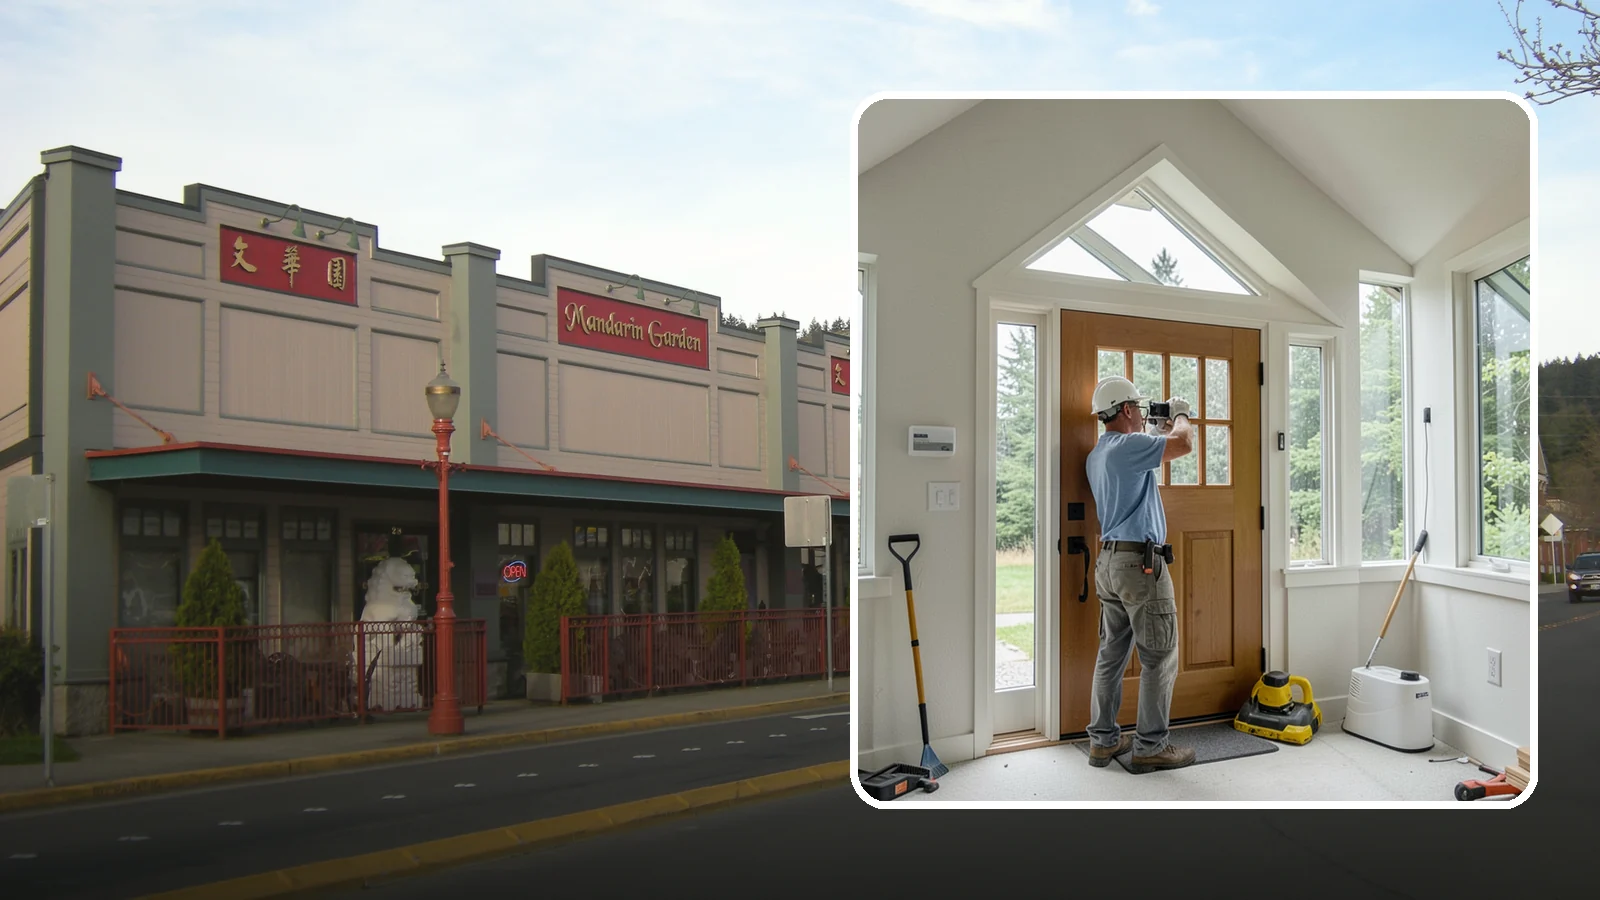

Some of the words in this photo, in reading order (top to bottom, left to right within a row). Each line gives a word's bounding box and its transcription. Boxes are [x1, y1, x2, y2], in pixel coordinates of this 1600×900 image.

[231, 235, 347, 291] 文華園
[564, 302, 644, 341] Mandarin
[648, 320, 701, 352] Garden
[503, 565, 527, 578] OPEN
